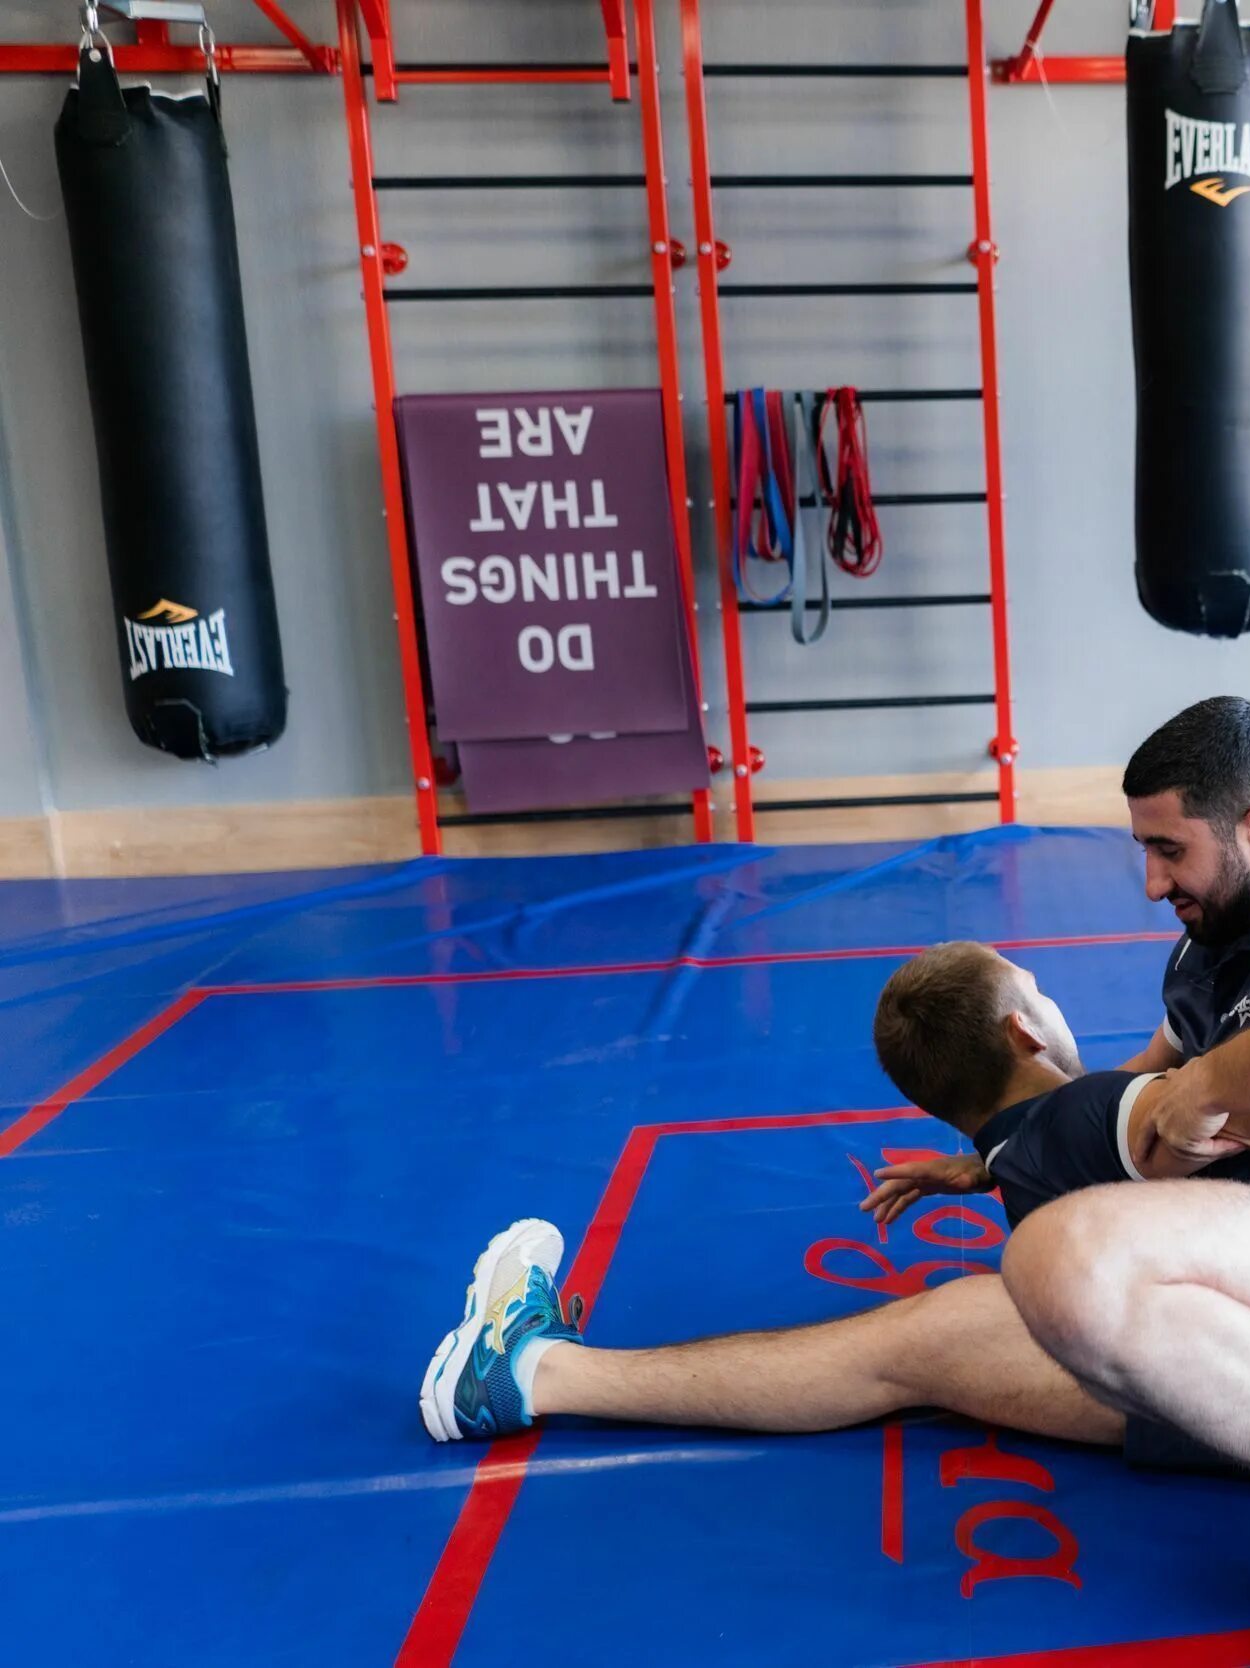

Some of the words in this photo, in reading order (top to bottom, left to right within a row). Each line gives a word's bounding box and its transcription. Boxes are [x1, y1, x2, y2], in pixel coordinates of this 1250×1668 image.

[475, 406, 594, 459] ARE
[469, 479, 619, 533] THAT
[440, 550, 658, 606] THINGS
[123, 608, 235, 681] EVERLAST
[517, 623, 595, 674] DO
